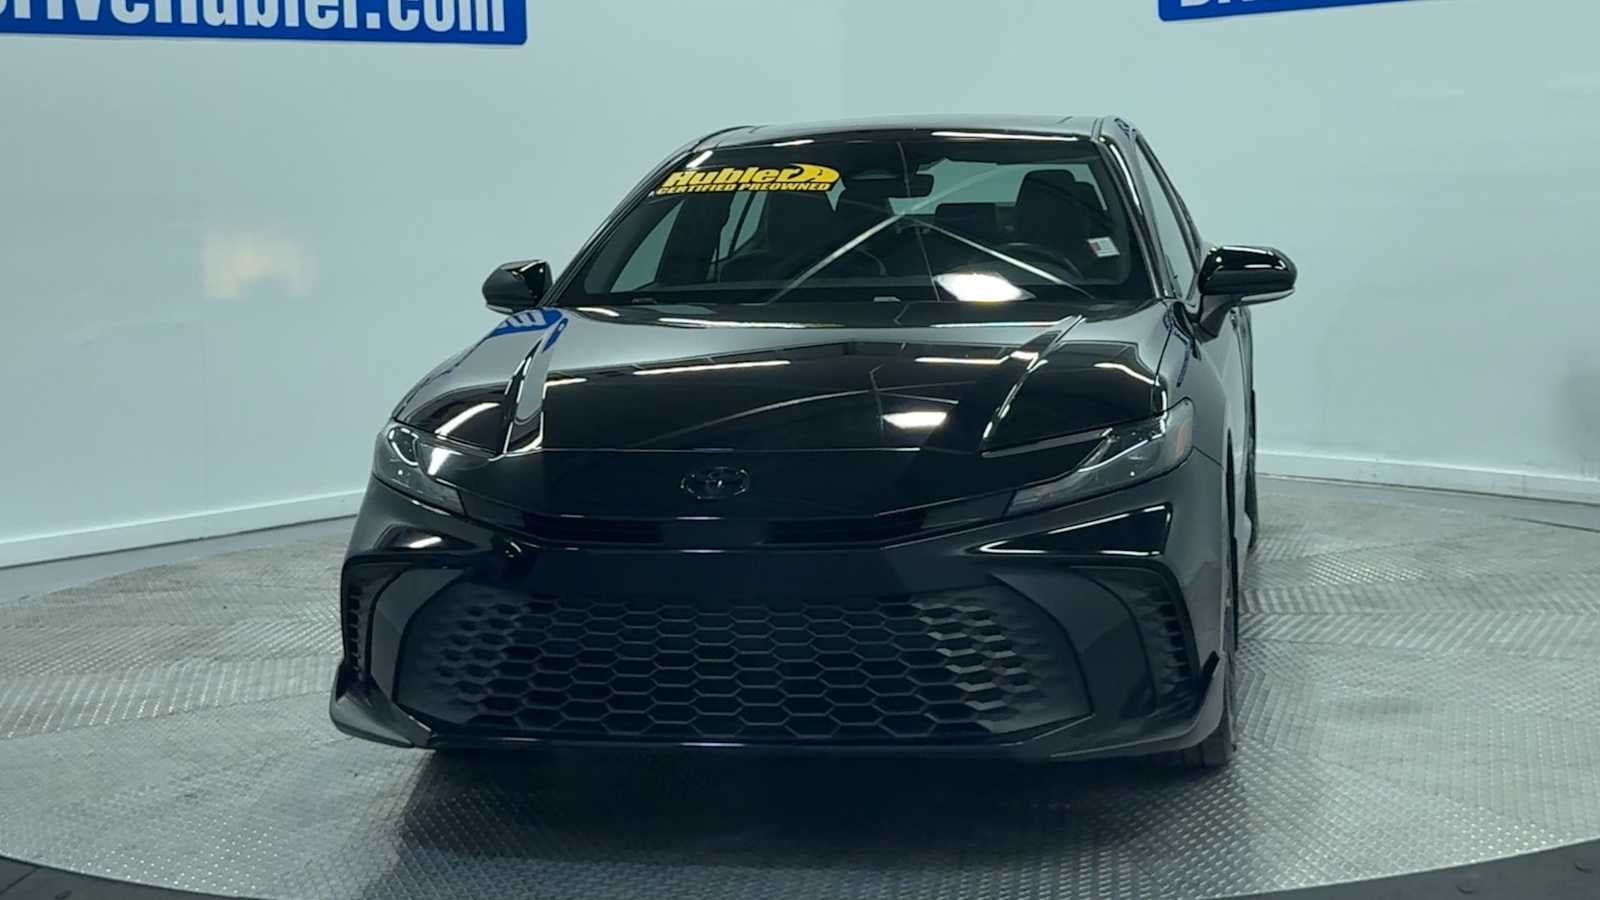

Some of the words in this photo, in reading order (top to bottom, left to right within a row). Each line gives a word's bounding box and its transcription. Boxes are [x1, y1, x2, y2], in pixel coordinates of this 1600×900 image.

[0, 0, 506, 32] veubler.com
[661, 167, 801, 187] Hubler
[655, 183, 738, 195] CERTIFIED
[738, 183, 832, 191] PREOWNED
